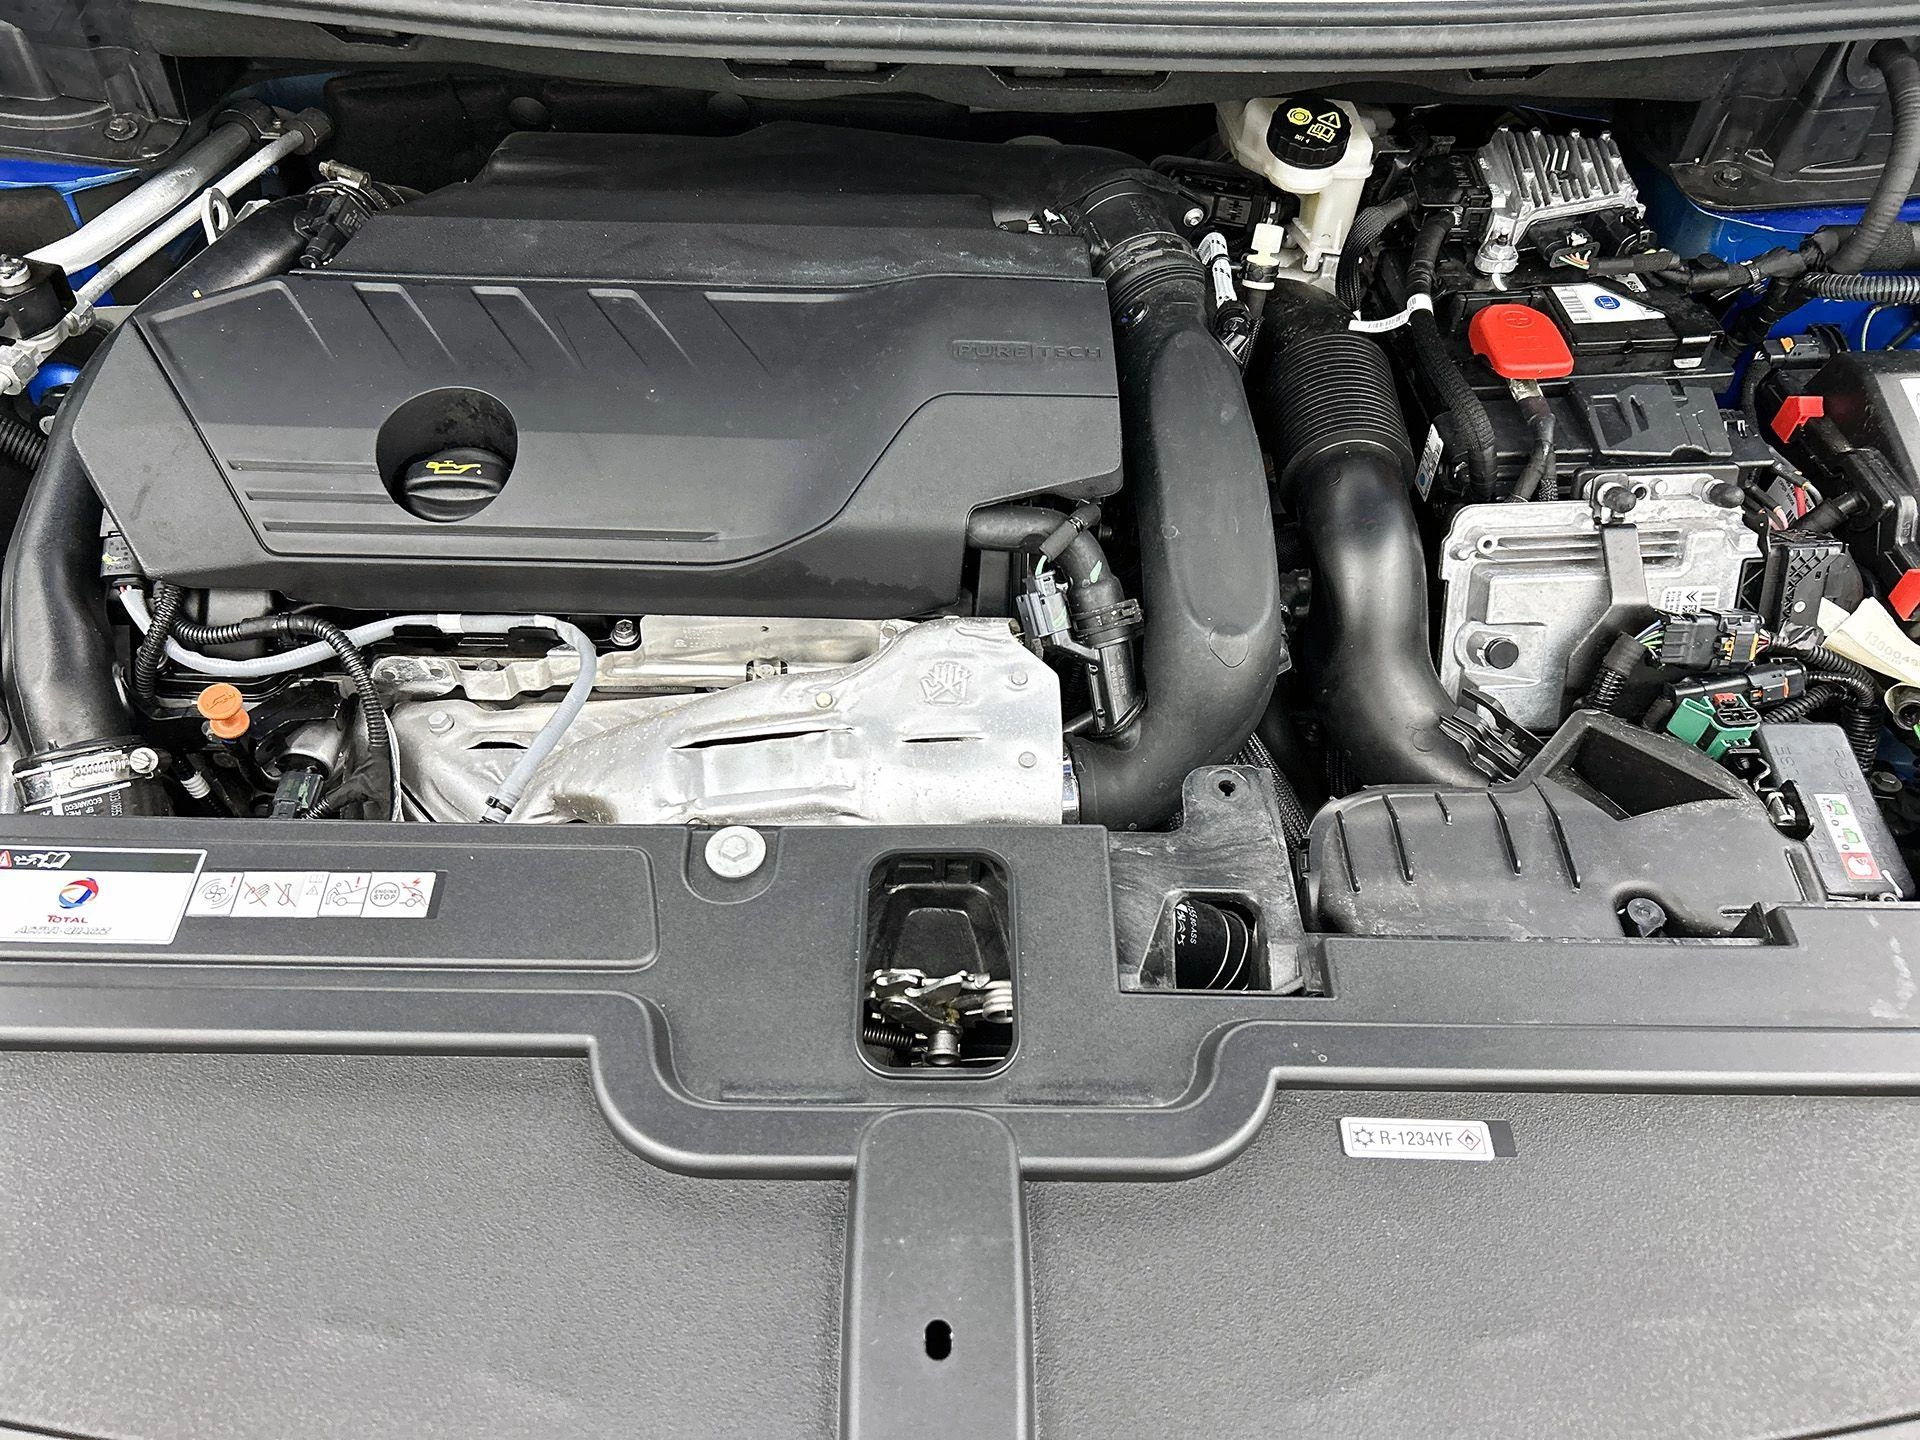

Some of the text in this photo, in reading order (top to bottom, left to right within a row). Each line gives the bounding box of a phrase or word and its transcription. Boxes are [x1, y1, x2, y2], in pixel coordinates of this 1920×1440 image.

[1035, 344, 1102, 360] TECH
[373, 893, 397, 901] STOP
[47, 914, 89, 924] TOTAL
[1379, 1130, 1454, 1147] R-1234YF
